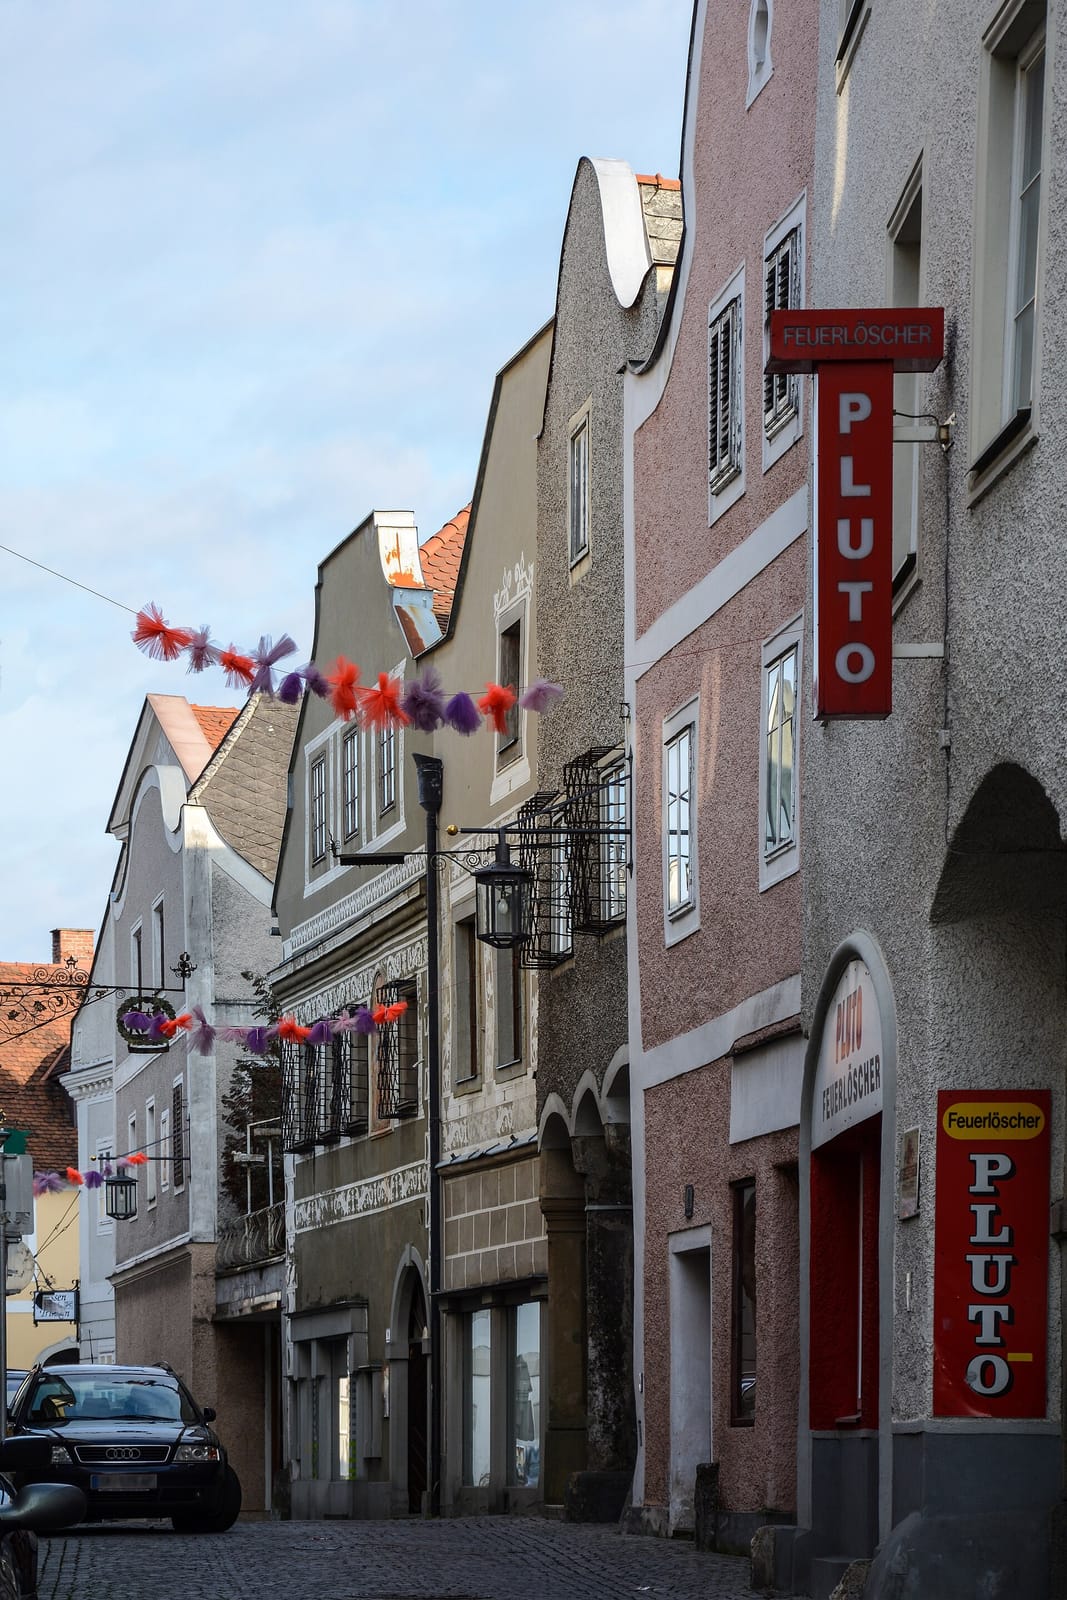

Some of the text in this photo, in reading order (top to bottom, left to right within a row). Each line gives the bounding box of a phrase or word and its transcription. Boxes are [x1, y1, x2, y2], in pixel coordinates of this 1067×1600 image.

[783, 320, 933, 346] FEUERLÖSCHER
[834, 392, 876, 684] PLUTO
[835, 985, 863, 1064] PLUTO
[822, 1054, 881, 1122] FEUERLÖSCHER
[947, 1110, 1042, 1130] Feuerlöscher
[965, 1153, 1016, 1396] PLUTO
